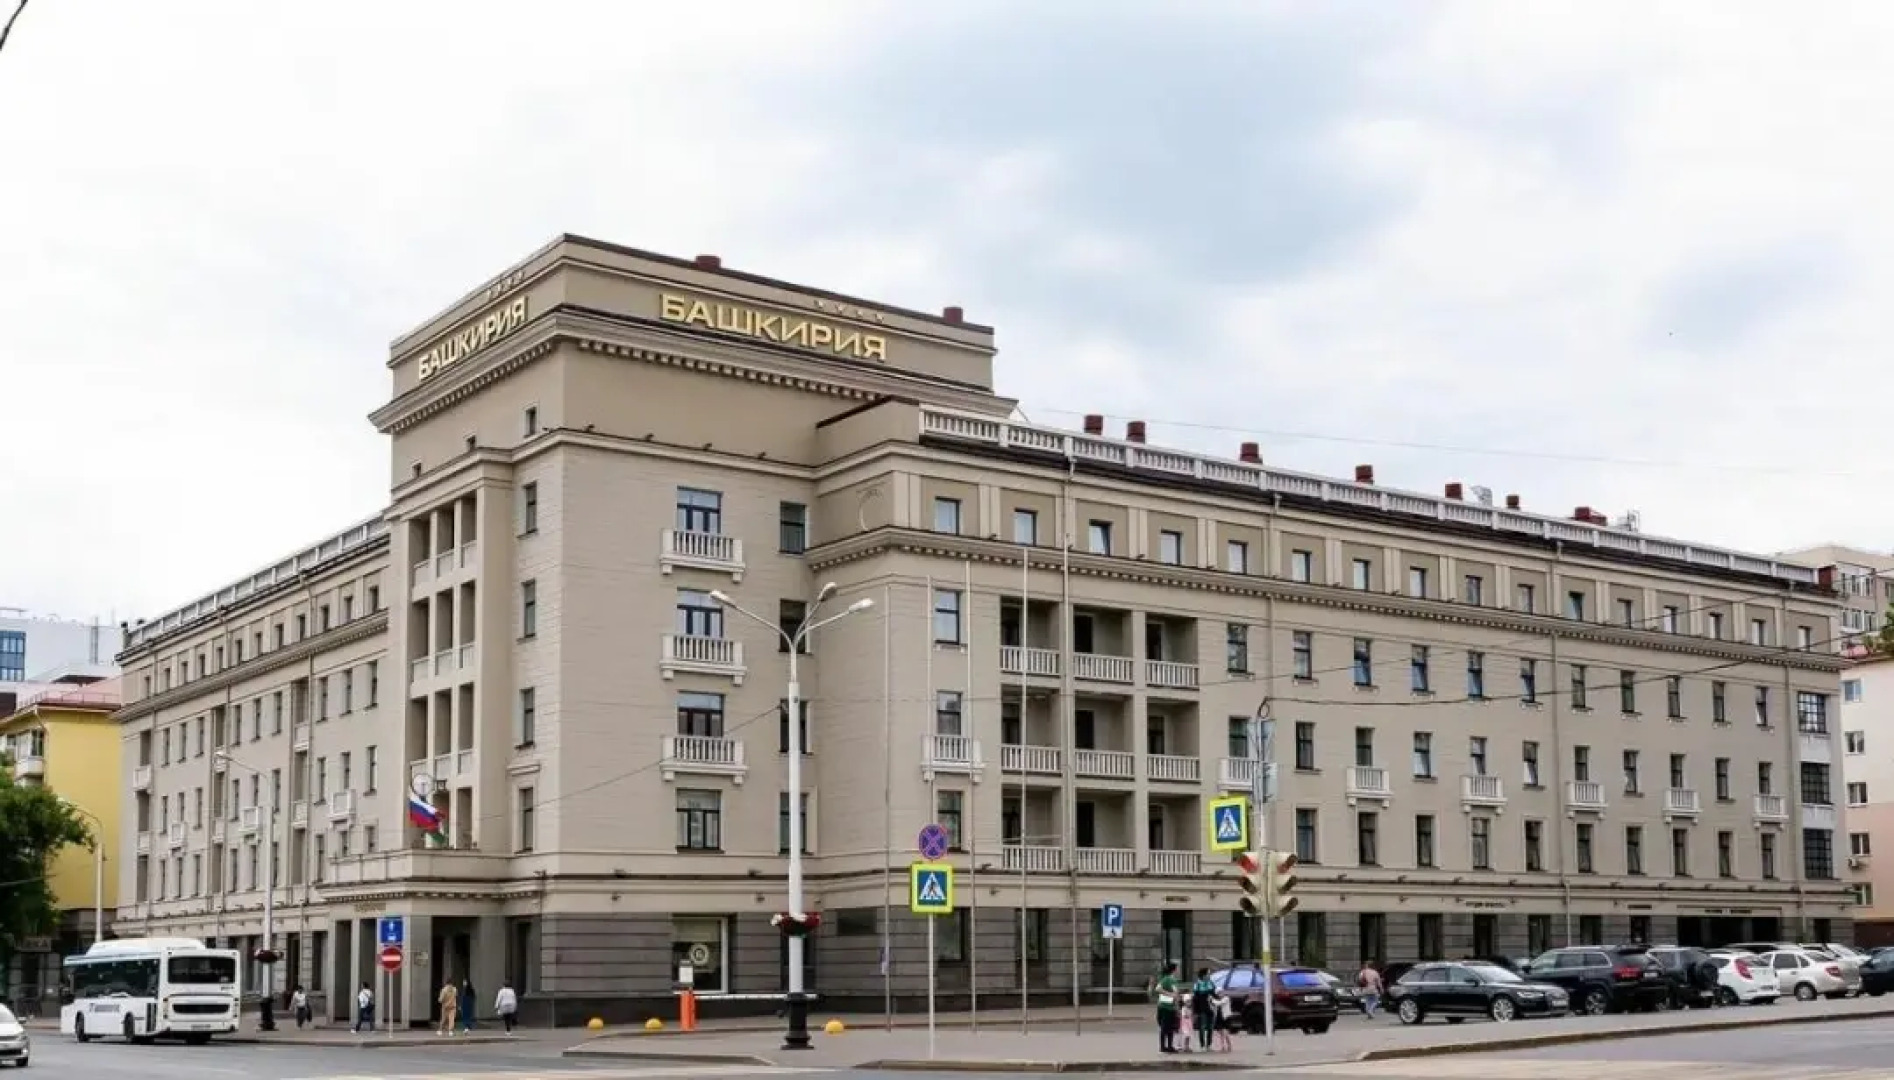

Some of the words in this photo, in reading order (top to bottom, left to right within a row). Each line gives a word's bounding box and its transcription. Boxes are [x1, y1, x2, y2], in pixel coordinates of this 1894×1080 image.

[418, 295, 527, 381] БАШКИРИЯ
[661, 293, 886, 360] БАШКИРИЯ
[1107, 906, 1120, 925] P
